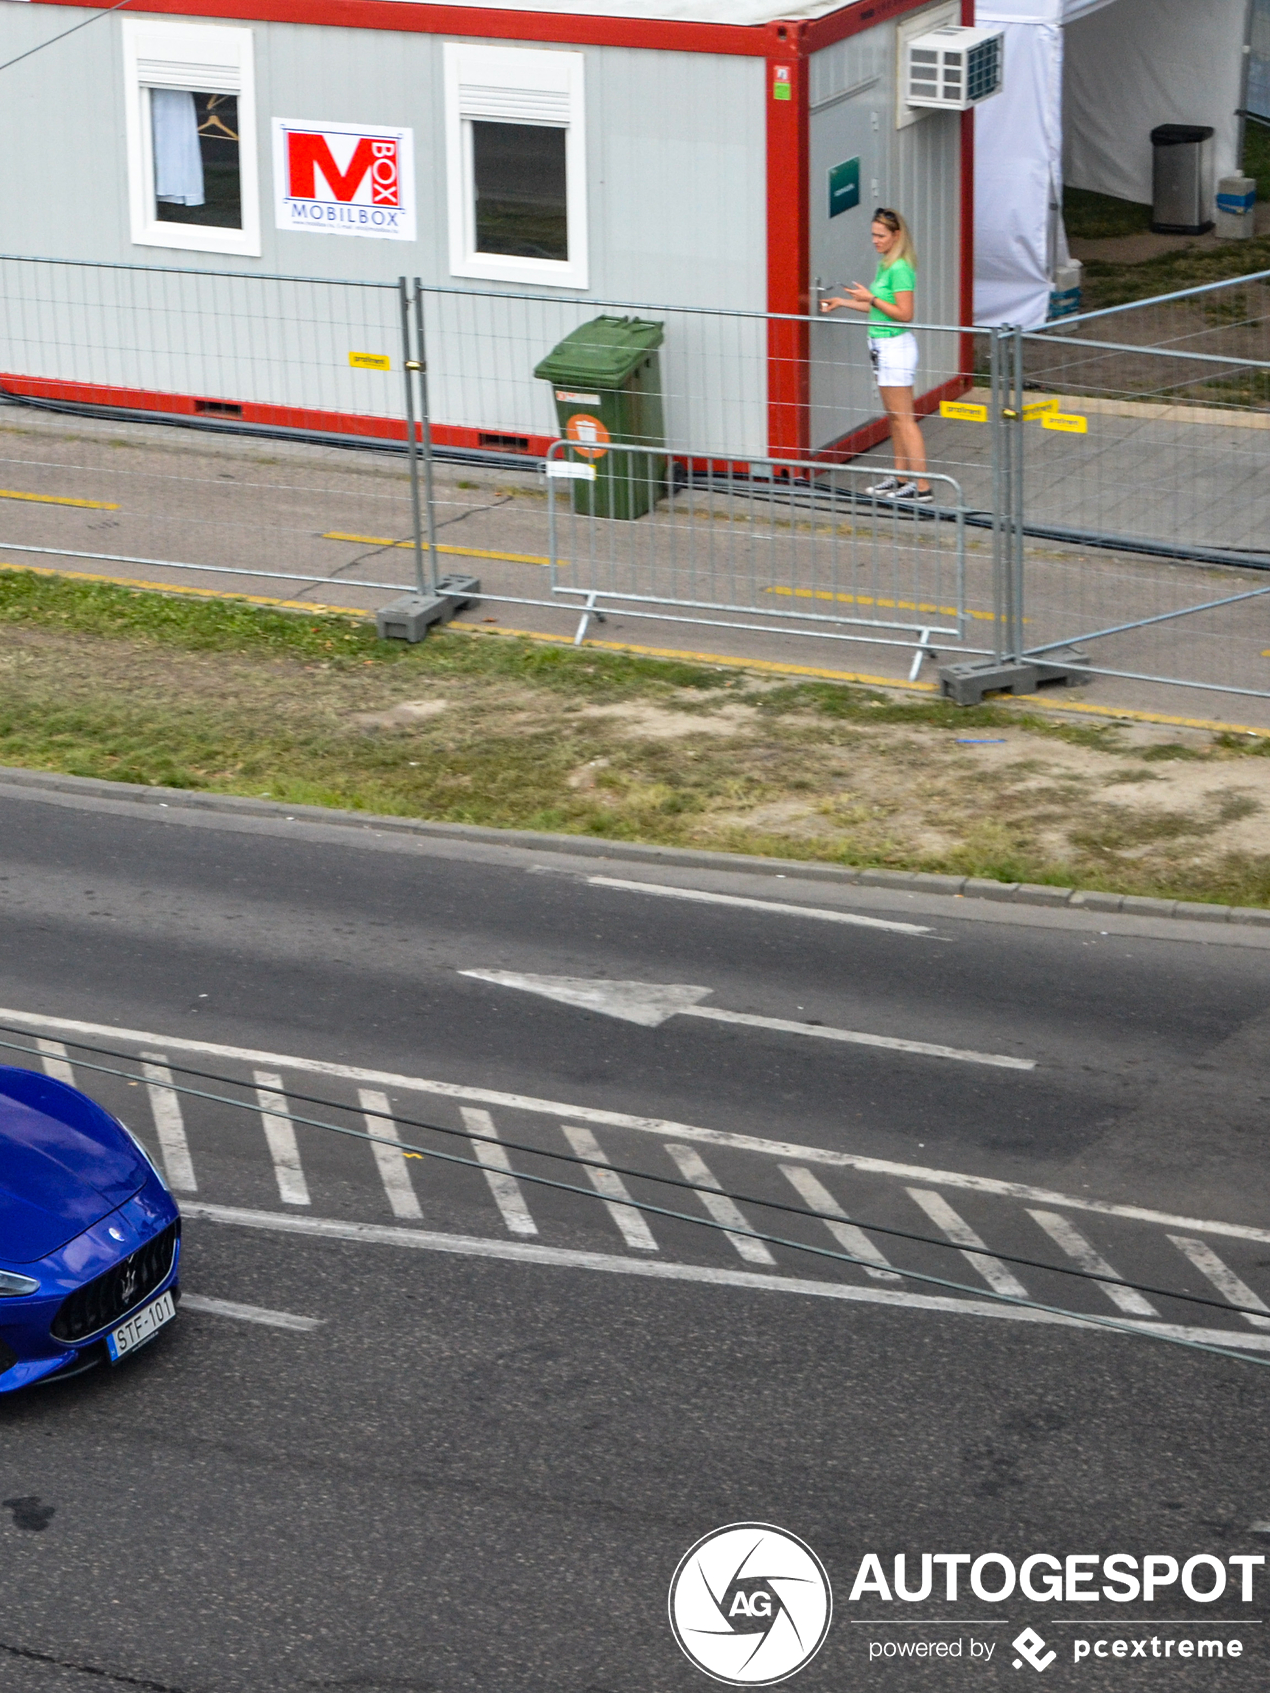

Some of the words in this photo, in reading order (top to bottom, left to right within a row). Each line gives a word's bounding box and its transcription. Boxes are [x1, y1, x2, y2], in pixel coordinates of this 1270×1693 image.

[371, 142, 398, 203] BOX
[291, 203, 400, 227] MOBILBOX
[116, 1296, 171, 1351] STF-101
